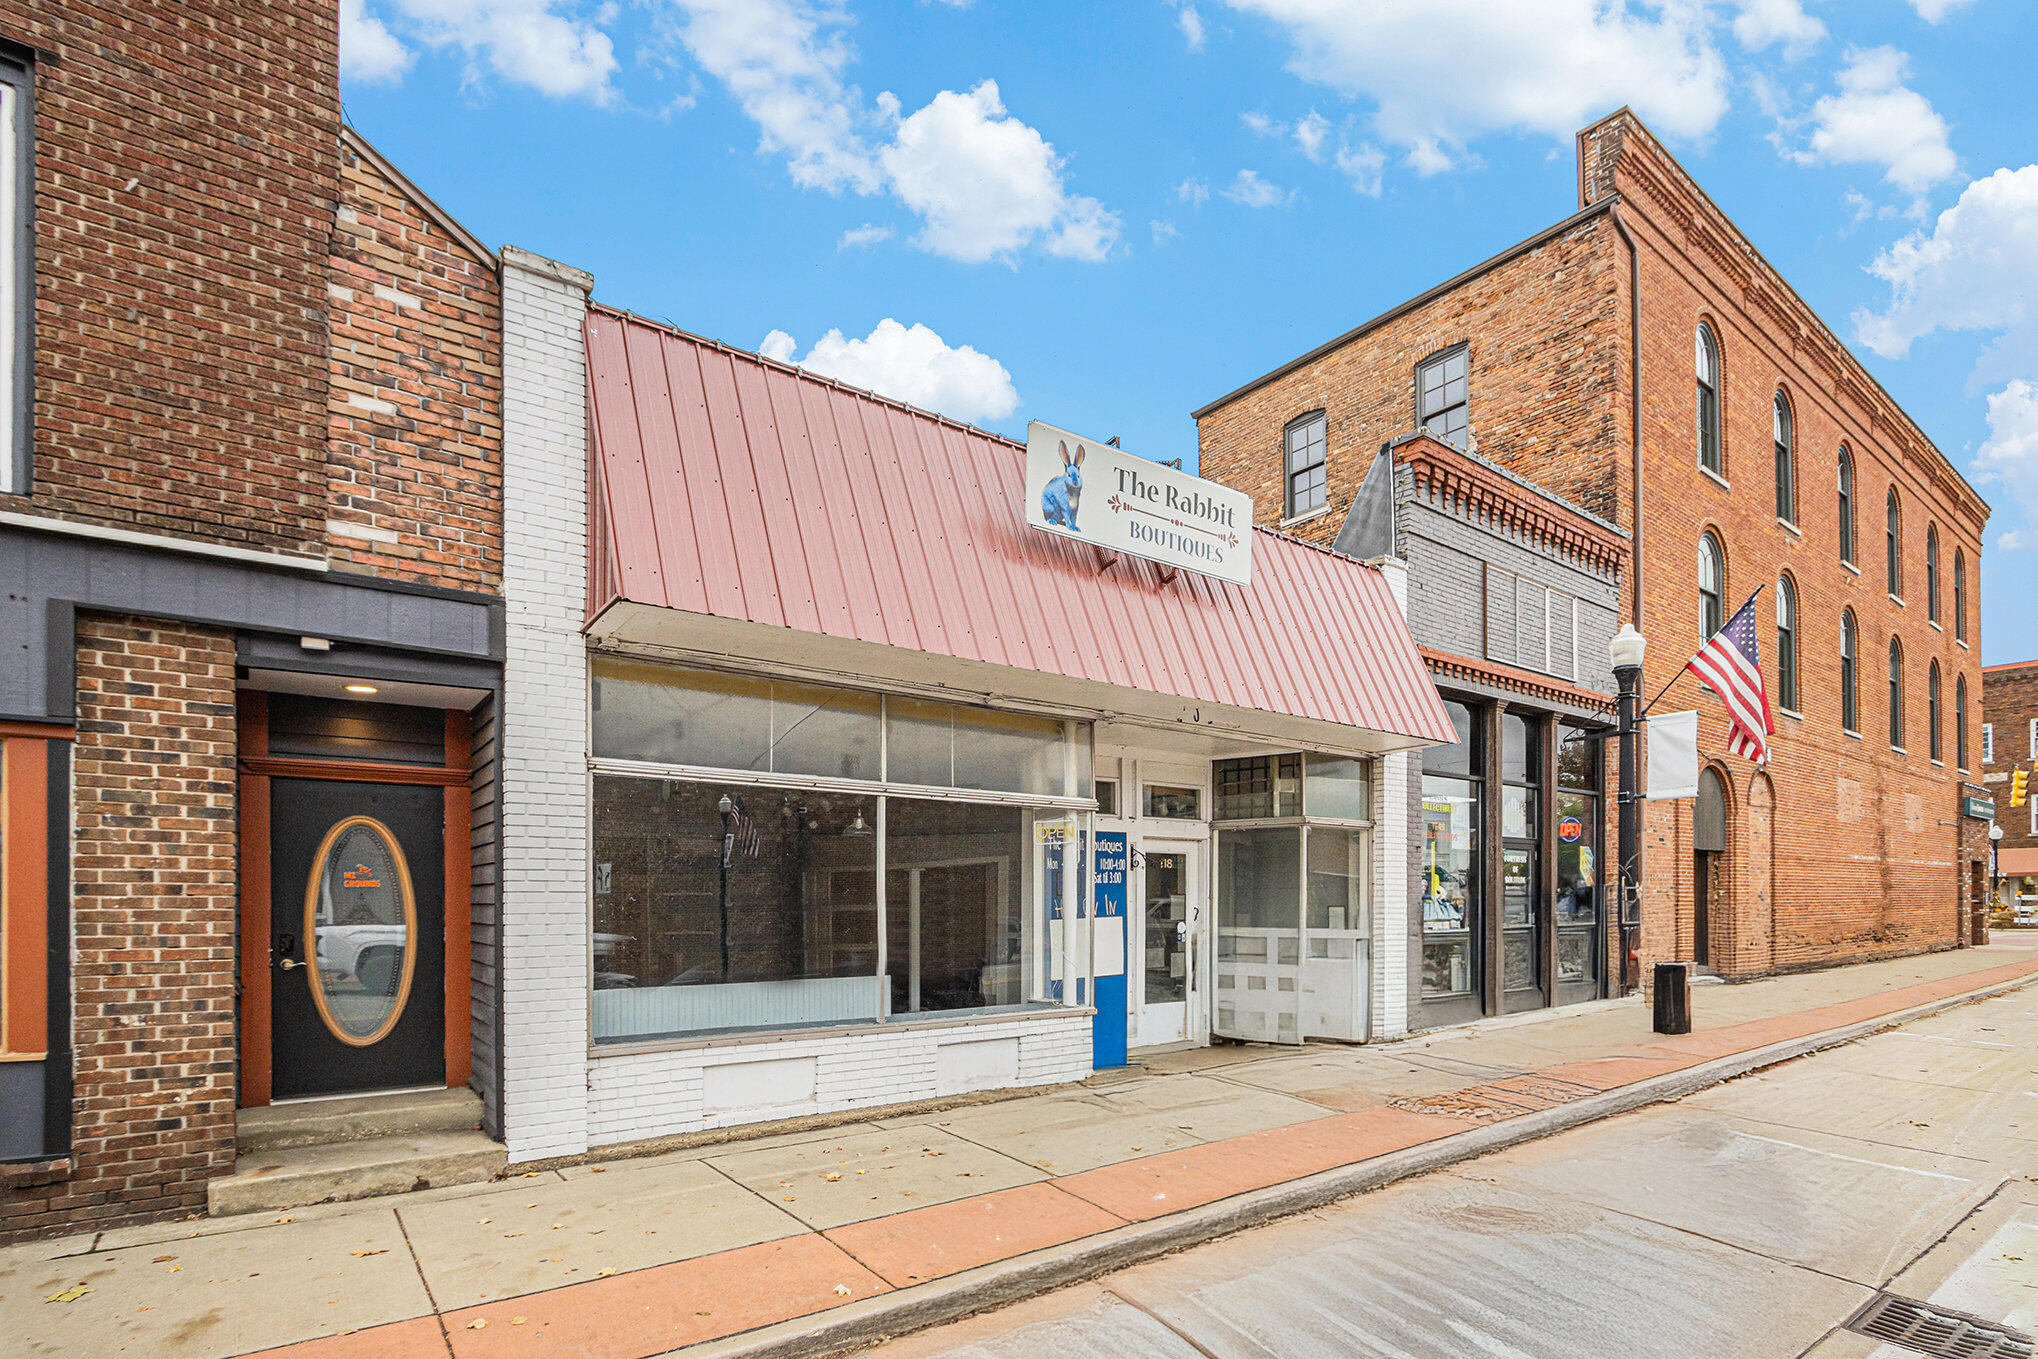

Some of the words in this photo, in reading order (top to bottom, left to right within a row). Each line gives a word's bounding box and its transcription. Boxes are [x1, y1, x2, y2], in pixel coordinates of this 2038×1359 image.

[1113, 466, 1160, 503] The
[1165, 483, 1236, 529] Rabbit
[1129, 520, 1224, 564] BOUTIQUES
[1036, 825, 1075, 840] OPEN
[1559, 822, 1582, 837] OPEN
[1046, 857, 1059, 870] Mon
[1099, 858, 1126, 871] 10:00-4:00
[1109, 871, 1122, 884] 3:00
